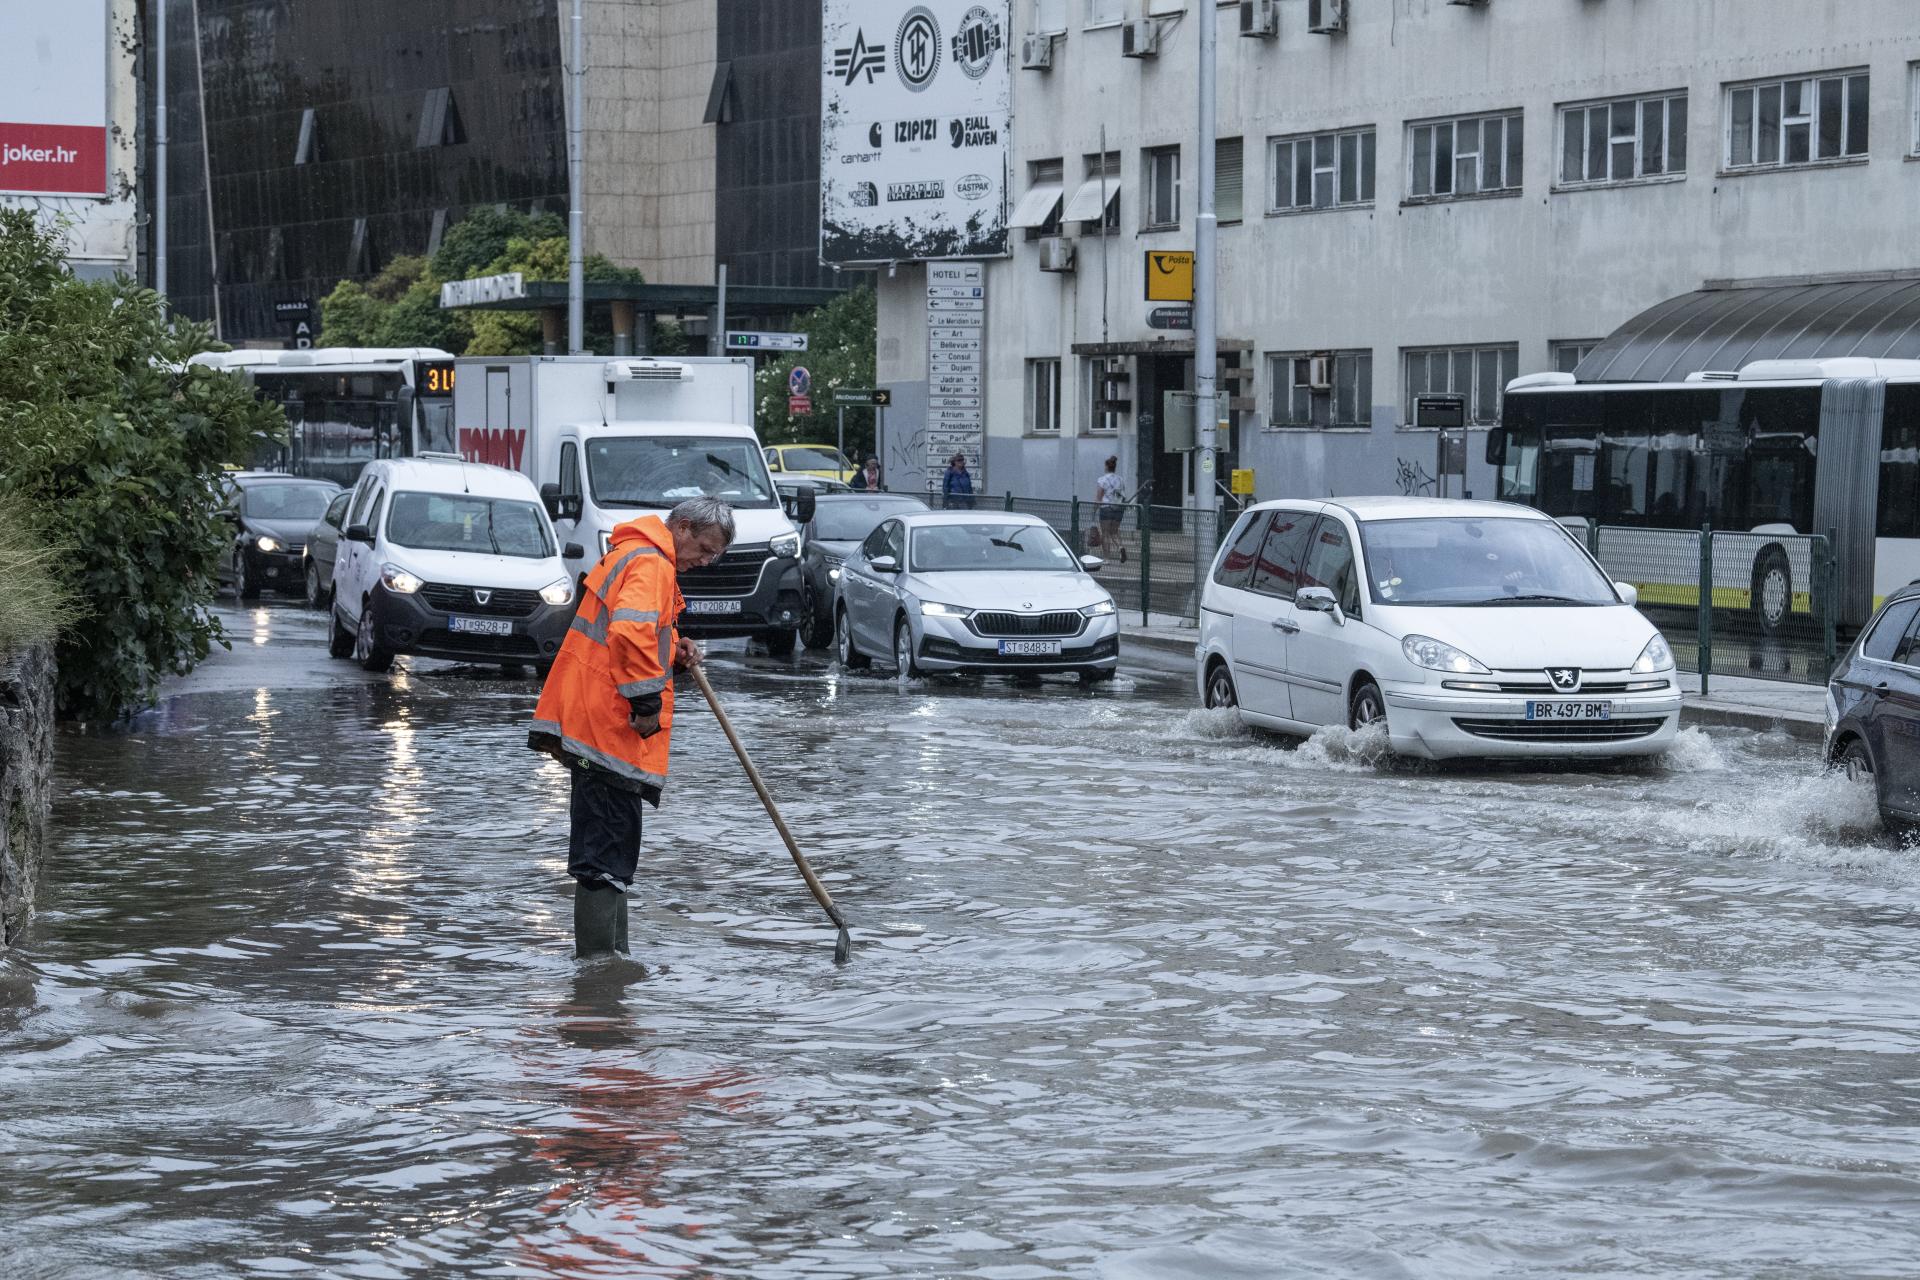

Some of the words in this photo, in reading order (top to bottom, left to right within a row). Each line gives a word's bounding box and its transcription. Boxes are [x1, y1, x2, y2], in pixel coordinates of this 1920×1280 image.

[894, 119, 937, 143] IZIPIZI
[2, 143, 78, 166] joker.hr
[841, 152, 881, 164] carhartt
[857, 182, 868, 190] THE
[957, 183, 989, 192] EASTPAK
[848, 190, 869, 199] NORTH
[888, 182, 944, 200] NAPAPIJRI
[853, 199, 869, 207] FACE
[933, 271, 960, 279] HOTELI
[948, 353, 971, 361] Consul
[951, 364, 973, 373] Dujam
[428, 369, 439, 391] 3
[940, 376, 964, 384] Jadran
[940, 386, 964, 395] Marjan
[942, 398, 962, 406] Globo
[940, 422, 973, 430] President
[949, 434, 967, 443] Park
[459, 428, 526, 472] TOMMY
[456, 619, 467, 631] ST
[1006, 643, 1018, 653] ST
[1023, 642, 1057, 653] 8483-T
[1536, 703, 1602, 718] BR-497-BM
